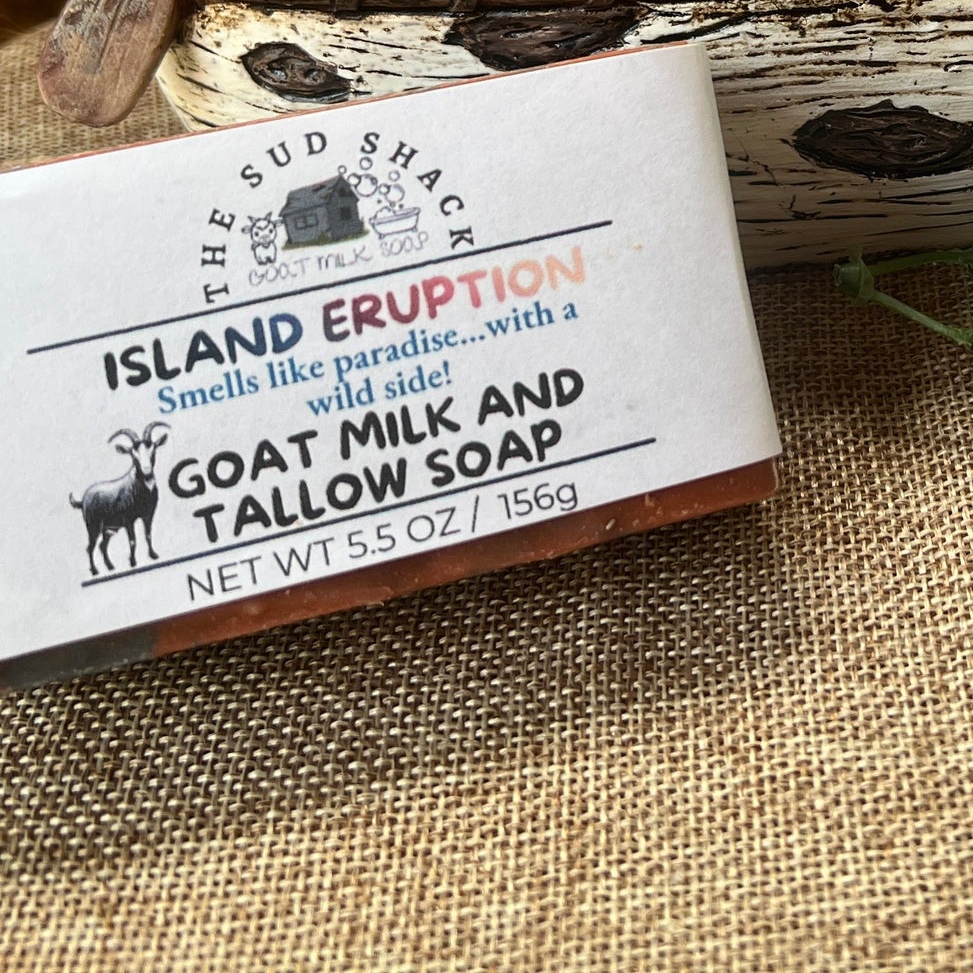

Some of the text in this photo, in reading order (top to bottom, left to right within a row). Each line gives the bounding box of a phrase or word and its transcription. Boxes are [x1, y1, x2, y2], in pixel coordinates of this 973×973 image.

[200, 131, 474, 304] THE SUD SHACK
[248, 231, 430, 287] GOAT MILK SOAP
[103, 245, 587, 391] ISLAND ERUPTION
[157, 368, 260, 414] Smells
[266, 355, 325, 388] like
[562, 302, 580, 320] a
[168, 368, 585, 500] GOAT MILK AND
[307, 360, 453, 416] wild side!
[186, 482, 579, 601] NET WT 5.5 OZ / 156g
[193, 419, 562, 544] TALLOW SOAP
